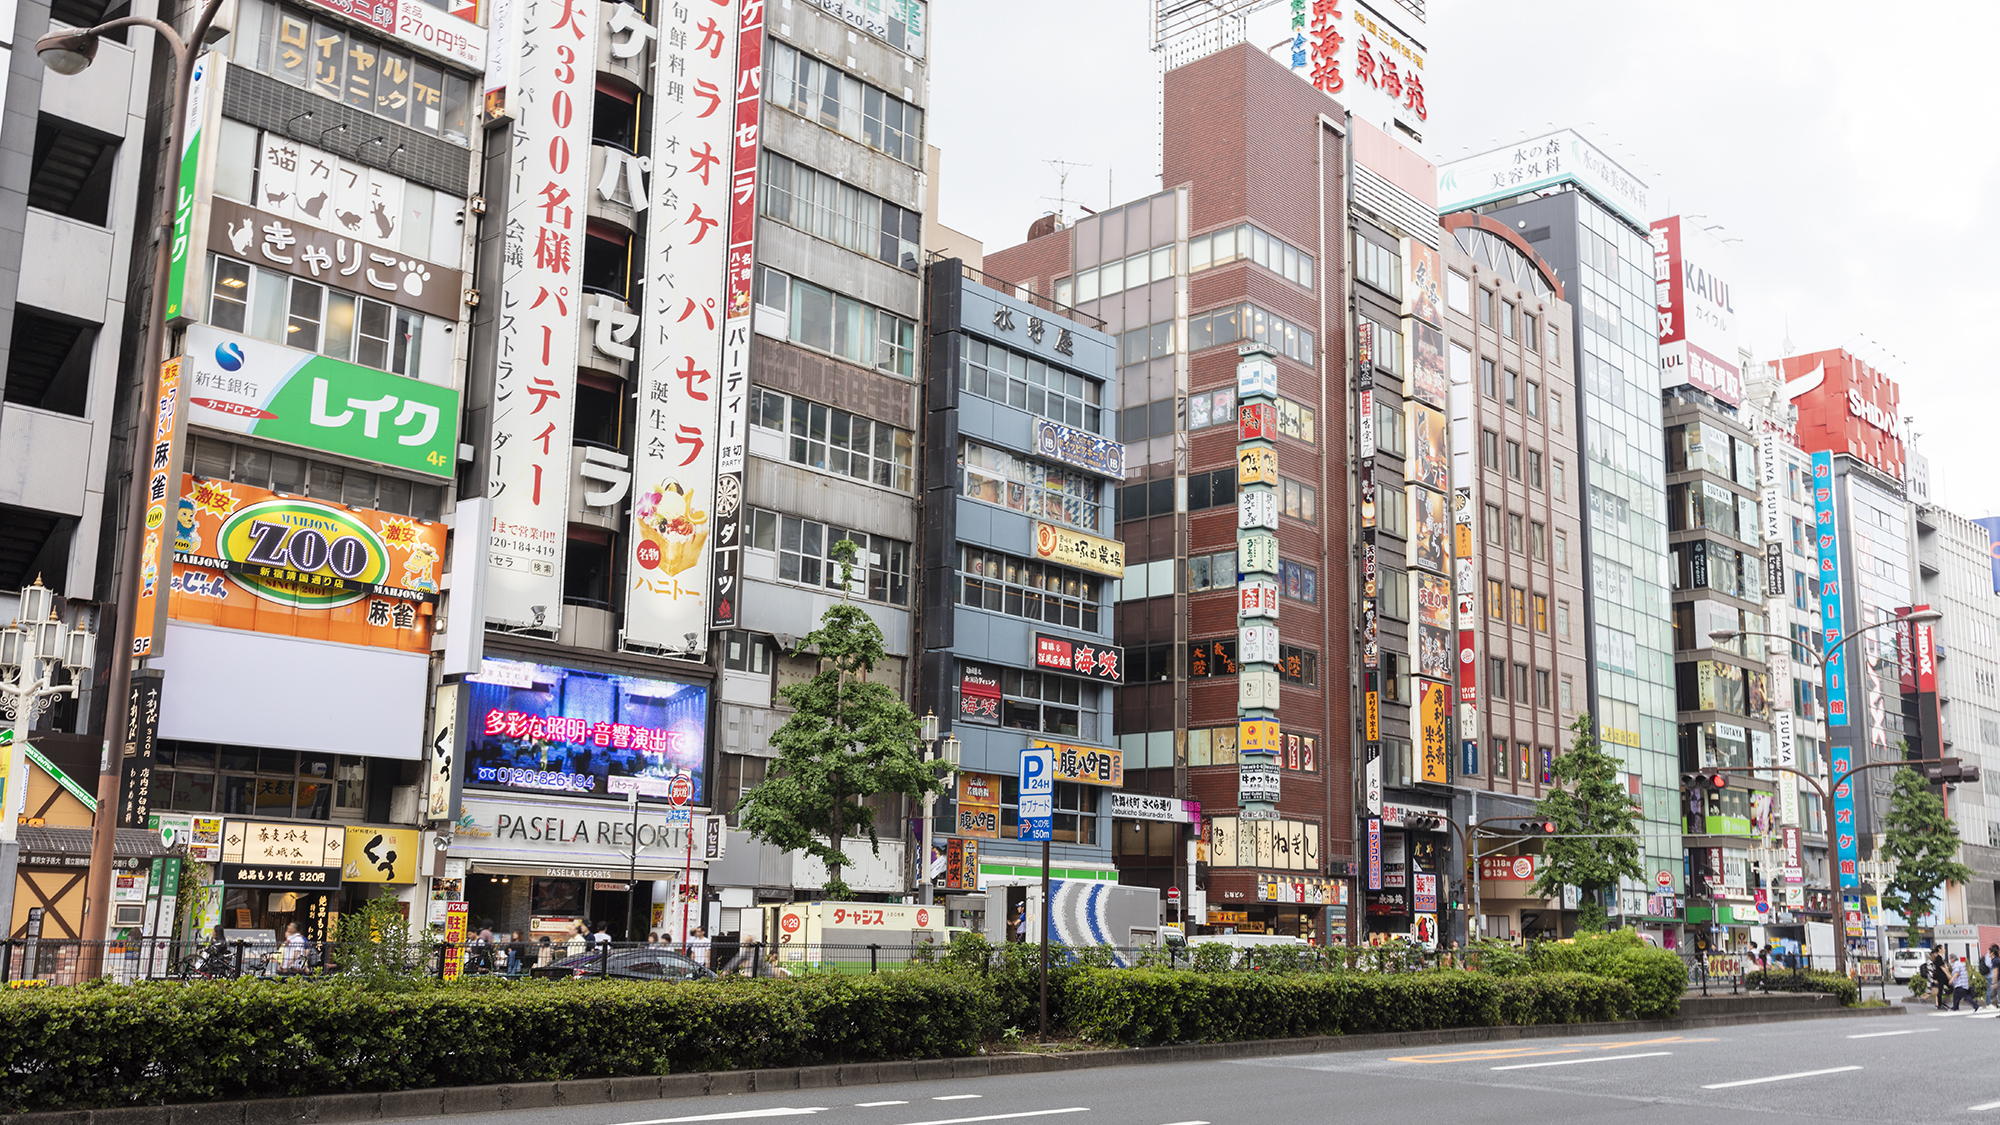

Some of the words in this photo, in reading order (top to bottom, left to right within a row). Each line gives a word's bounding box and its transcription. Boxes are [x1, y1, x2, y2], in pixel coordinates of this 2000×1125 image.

[281, 15, 408, 85] ロイヤル
[400, 15, 481, 51] 270円均一
[281, 49, 408, 110] クリニック
[1355, 33, 1427, 121] 東海苑
[1513, 138, 1561, 166] 水の森
[267, 146, 383, 198] 猫カフェ
[1492, 156, 1561, 189] 美容外科
[172, 186, 193, 264] レイク
[674, 0, 731, 468] カラオケパセラ
[260, 220, 400, 293] きゃりこ
[1684, 259, 1735, 315] KAIUL
[992, 305, 1075, 357] 水野屋
[195, 370, 259, 399] 新生銀行
[726, 327, 747, 438] パーティー
[207, 399, 263, 418] カードローン
[310, 376, 441, 447] レイク
[151, 441, 171, 502] 麻雀
[426, 450, 448, 468] 4F
[721, 459, 742, 468] PARTY
[1763, 435, 1775, 483] TSUTAYA
[281, 512, 339, 533] MAHJONG
[1767, 490, 1778, 538] TSUTAYA
[247, 520, 369, 579] ZOO
[638, 547, 661, 562] 名物
[717, 523, 738, 596] ダーツ
[533, 562, 552, 575] 検索
[373, 585, 424, 602] MAHJONG
[634, 575, 702, 602] ハニトー
[368, 599, 416, 629] 麻雀
[133, 639, 150, 655] 3F
[1074, 644, 1121, 681] 海峡
[1720, 724, 1743, 739] TSUTAYA
[1780, 714, 1791, 764] TSUTAYA
[1023, 755, 1045, 790] P
[1059, 747, 1112, 782] 腹八分目
[1031, 778, 1050, 790] 24H
[960, 809, 997, 833] 腹八分目
[1021, 799, 1050, 814] サブナード
[1032, 819, 1050, 828] この先
[1833, 757, 1857, 875] カラオケ館
[496, 813, 591, 844] PASELA
[596, 820, 698, 851] RESORTS
[707, 821, 719, 857] パセラ
[1032, 829, 1050, 839] 150m
[1272, 830, 1318, 860] ねぎし
[237, 869, 295, 882] 絶品もりそば
[299, 870, 327, 883] 320円
[546, 868, 576, 878] PASELA
[578, 870, 612, 880] RESORTS
[443, 915, 461, 980] 駐停車禁
